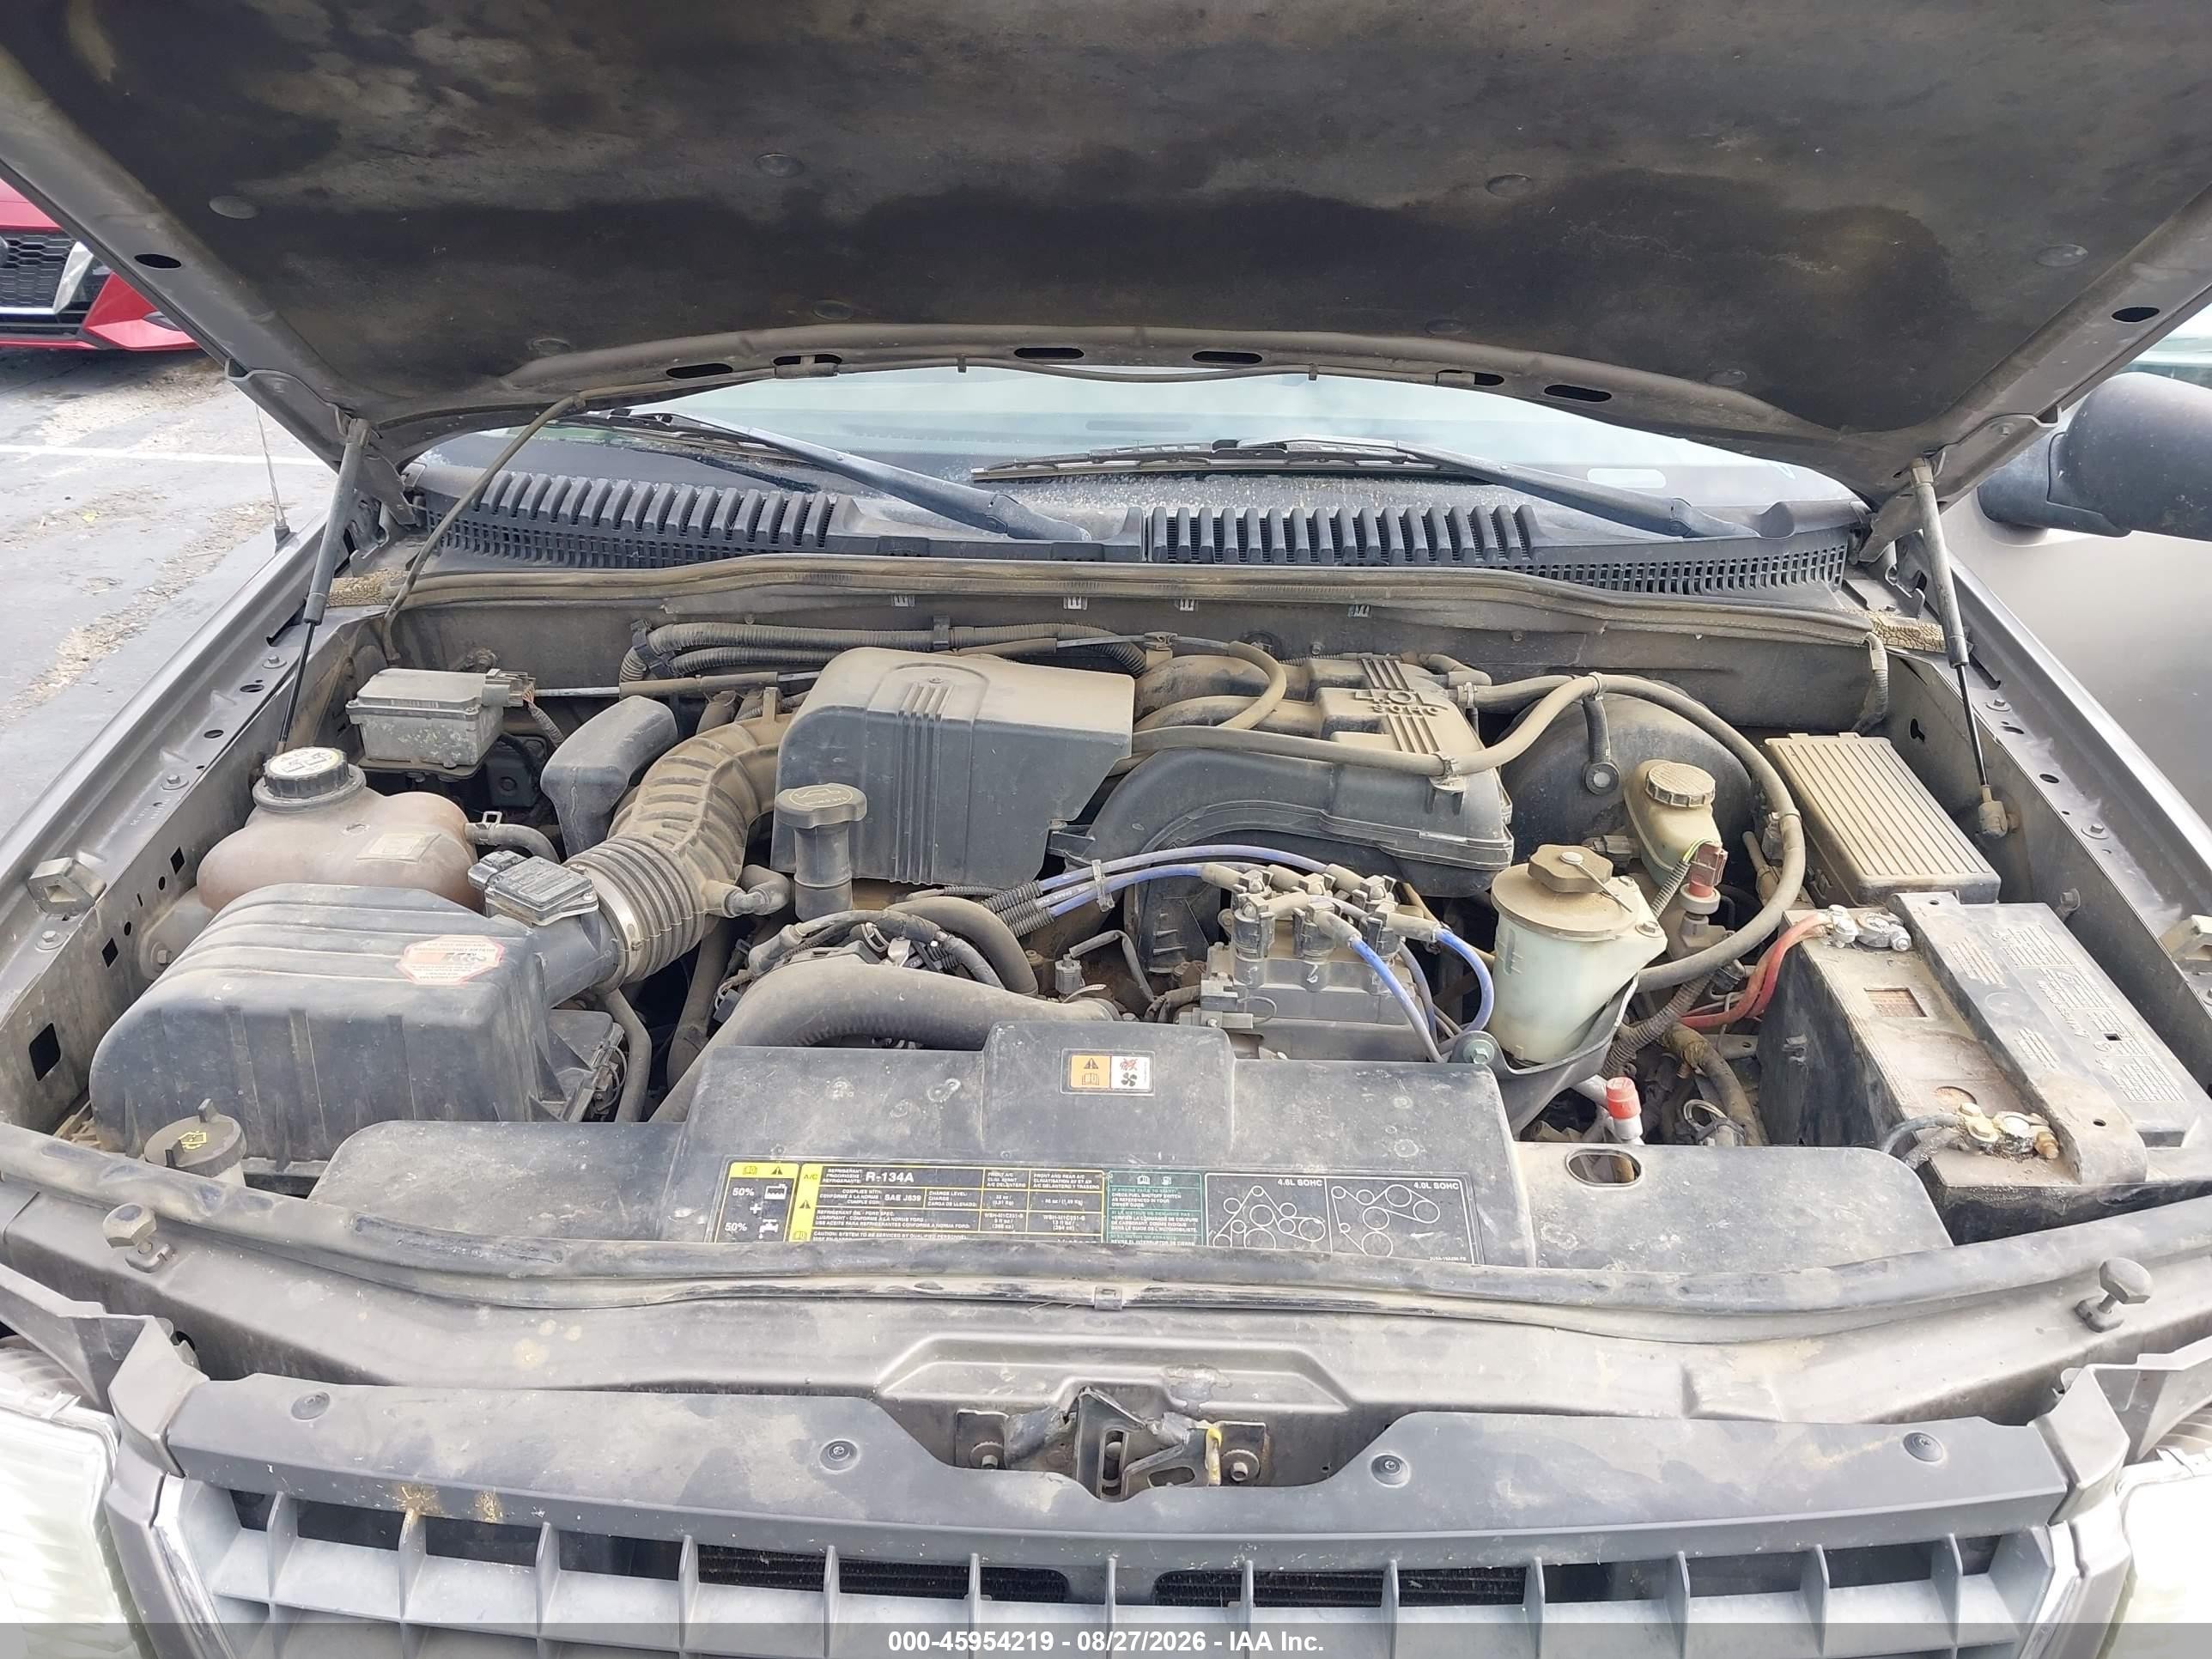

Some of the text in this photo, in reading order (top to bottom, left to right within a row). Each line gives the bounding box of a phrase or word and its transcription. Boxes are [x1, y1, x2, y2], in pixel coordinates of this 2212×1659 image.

[1373, 704, 1440, 716] SOHC
[865, 1171, 915, 1182] R-134A
[732, 1187, 755, 1197] 50%
[725, 1222, 748, 1232] 50%
